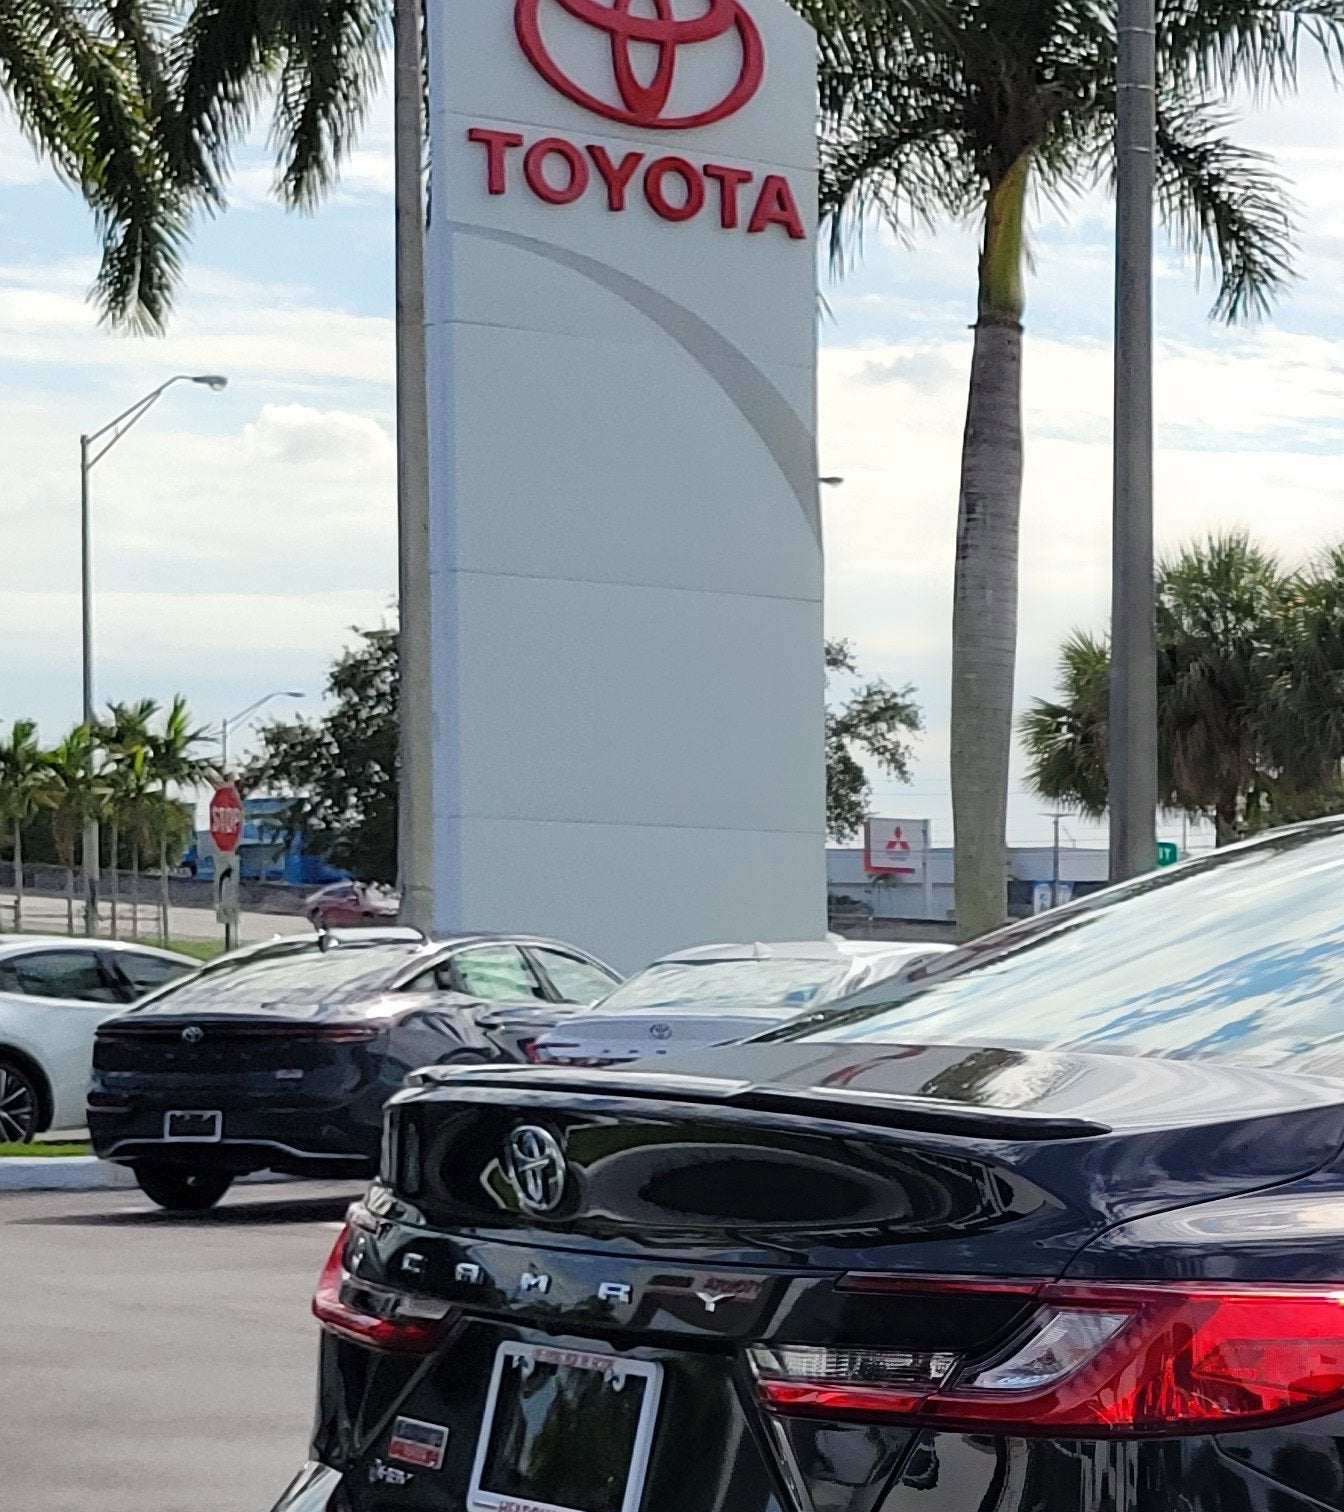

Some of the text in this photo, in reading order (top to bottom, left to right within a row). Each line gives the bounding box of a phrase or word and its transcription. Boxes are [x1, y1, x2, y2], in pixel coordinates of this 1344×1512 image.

[468, 127, 806, 240] TOYOTA
[212, 806, 241, 832] STOP
[401, 1252, 735, 1312] CAMRY
